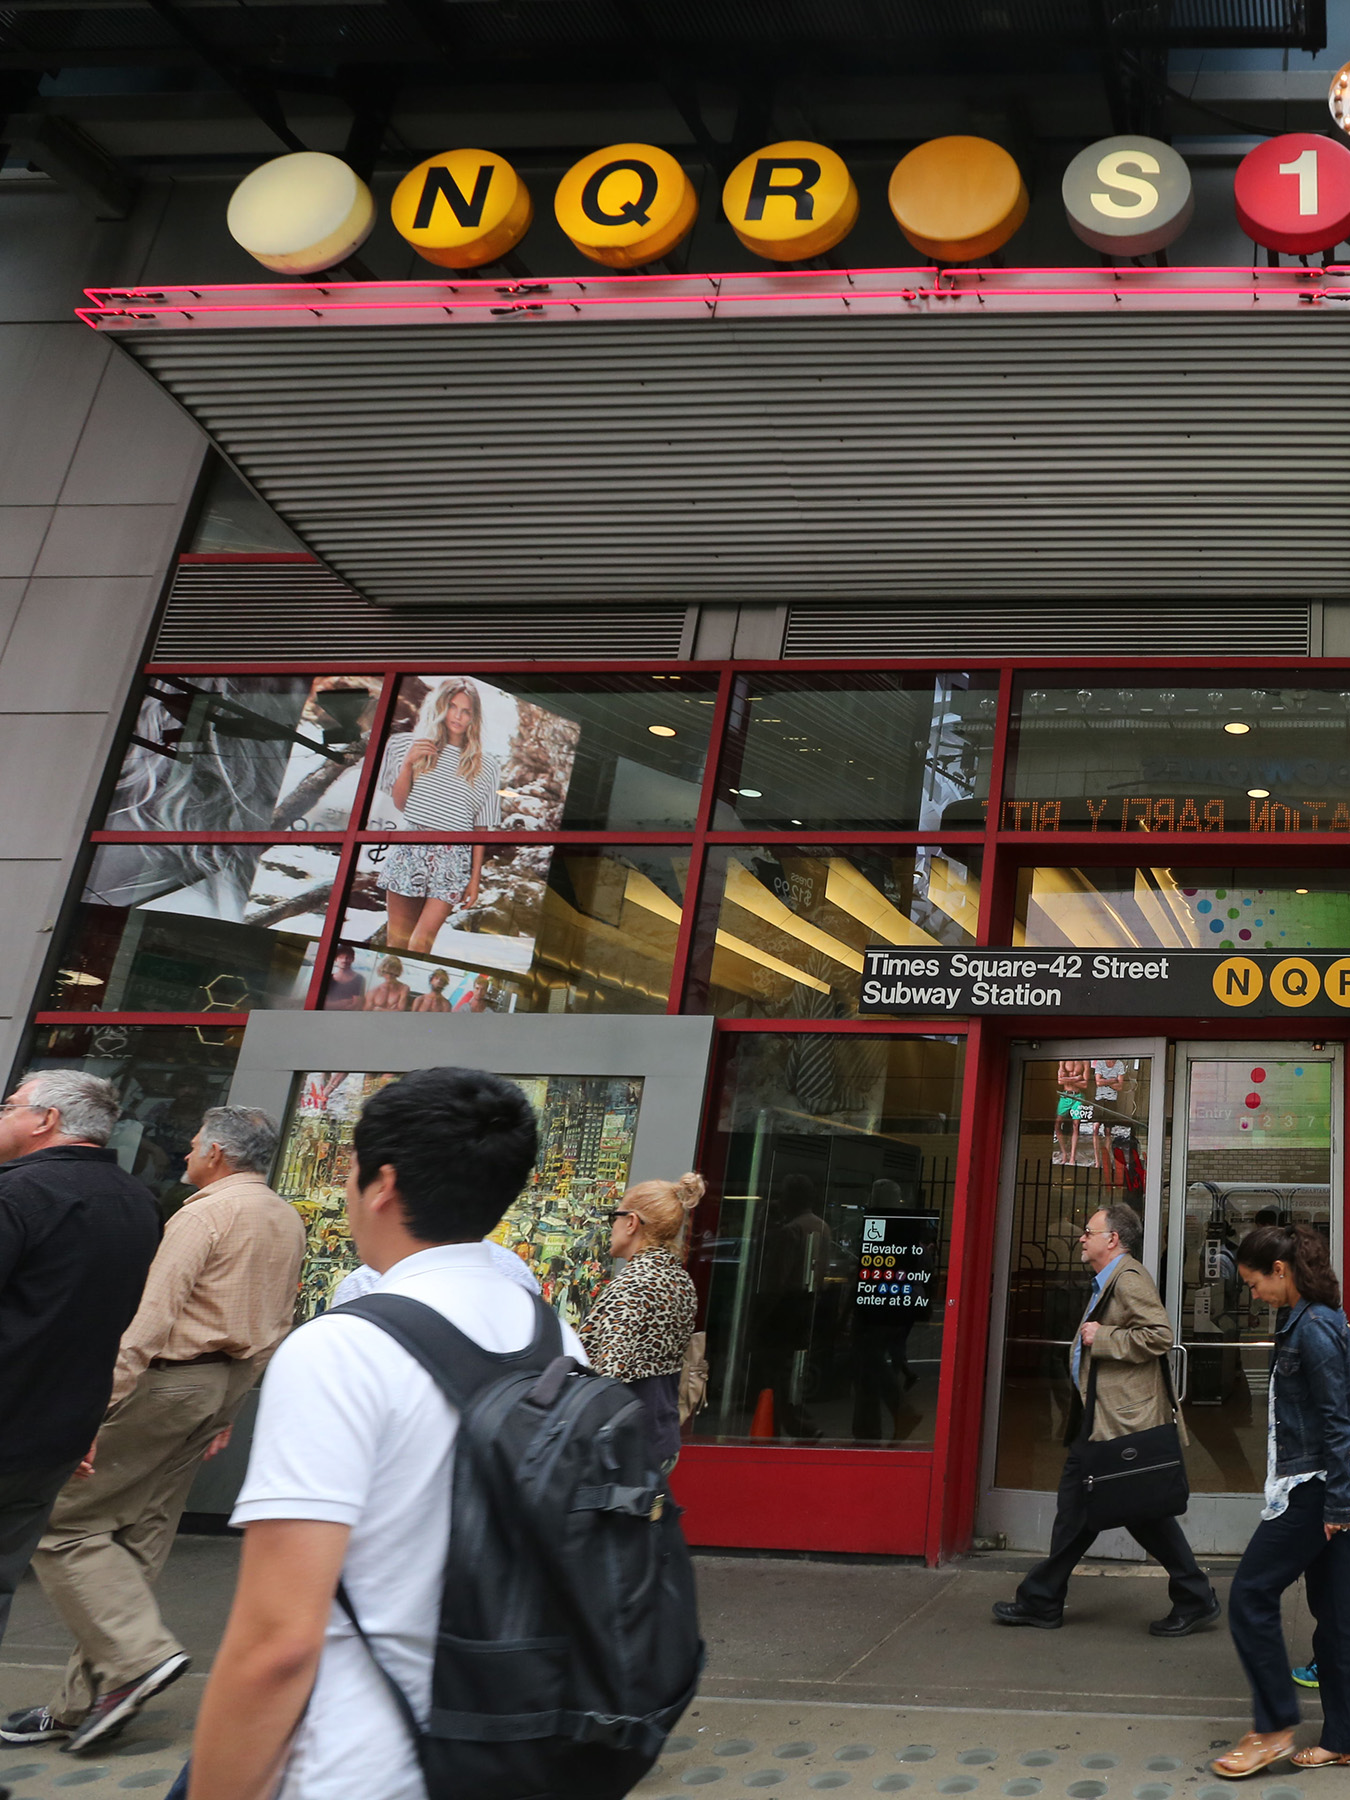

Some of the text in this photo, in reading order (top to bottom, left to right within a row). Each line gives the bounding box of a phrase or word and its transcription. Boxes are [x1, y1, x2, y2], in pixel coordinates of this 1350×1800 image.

[412, 166, 494, 230] N
[580, 157, 658, 228] Q
[744, 157, 822, 220] R
[1090, 150, 1159, 219] S
[1277, 150, 1319, 216] 1
[867, 953, 1169, 981] Times Square-42 Street
[1225, 968, 1250, 995] N
[1280, 967, 1310, 997] Q
[863, 982, 1061, 1009] Subway Station
[1197, 1107, 1232, 1119] Entry
[1263, 1116, 1271, 1127] 2
[1284, 1116, 1293, 1127] 3
[1308, 1116, 1315, 1127] 7
[862, 1243, 923, 1255] Elevator to
[874, 1271, 880, 1279] 2
[886, 1271, 892, 1279] 3
[907, 1270, 931, 1283] only
[857, 1282, 910, 1293] For A C E
[856, 1296, 929, 1307] enter at 8 Av
